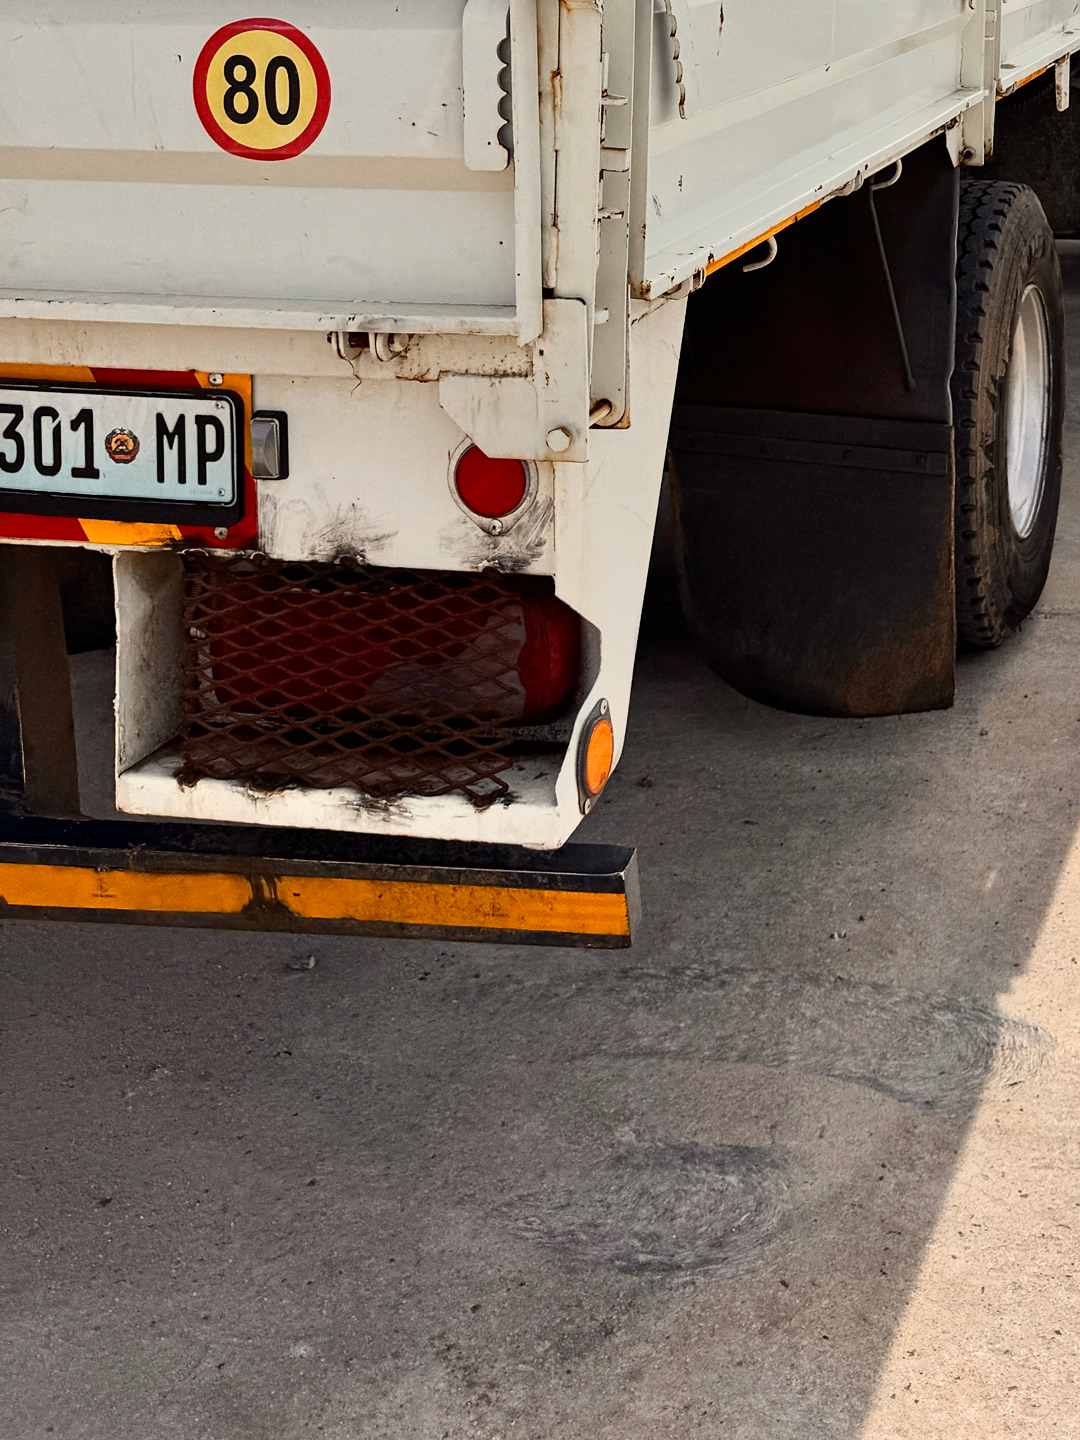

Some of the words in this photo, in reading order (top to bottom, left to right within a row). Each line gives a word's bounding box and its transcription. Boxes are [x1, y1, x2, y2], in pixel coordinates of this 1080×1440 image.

[224, 54, 301, 126] 80
[0, 403, 100, 480] 301
[156, 412, 226, 486] MP
